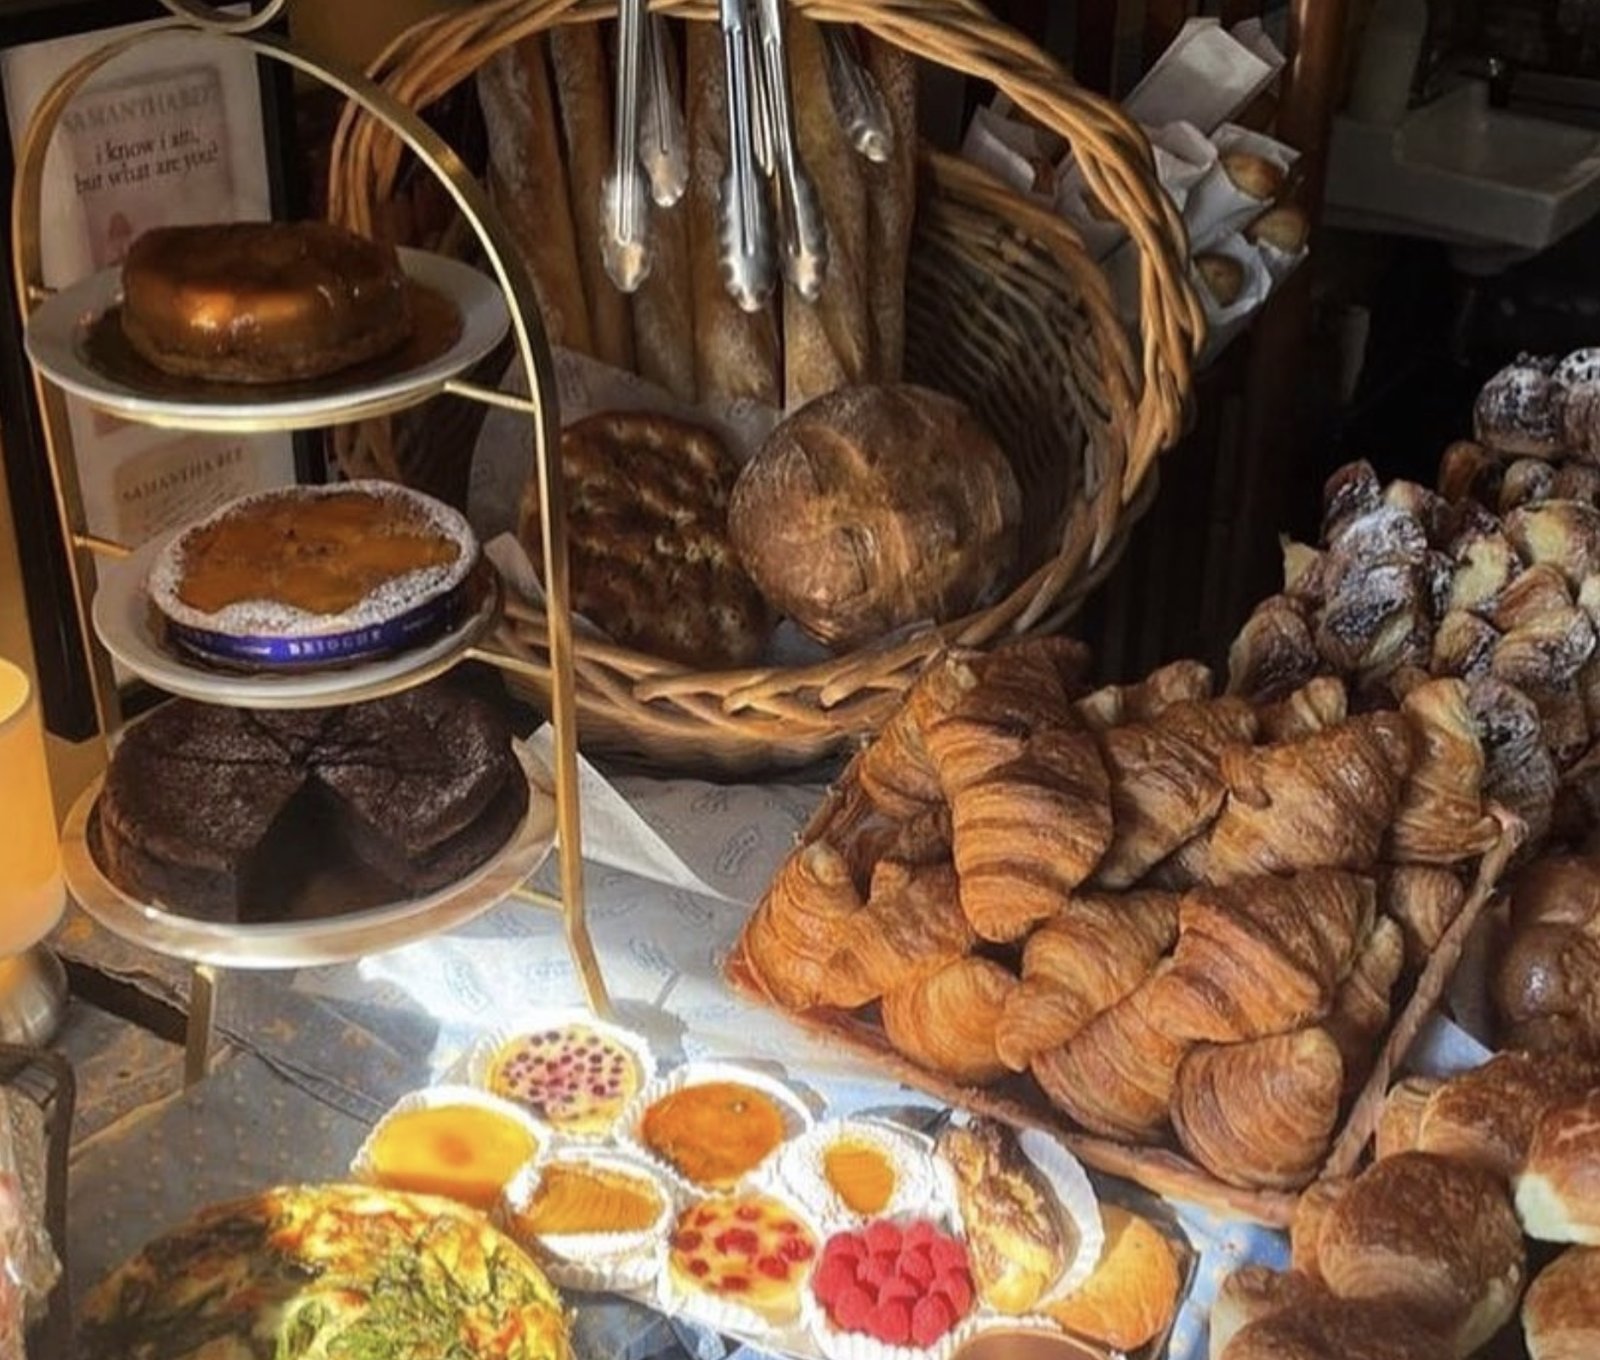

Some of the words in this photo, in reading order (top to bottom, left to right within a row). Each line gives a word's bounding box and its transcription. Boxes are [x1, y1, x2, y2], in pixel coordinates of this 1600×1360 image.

[105, 138, 155, 162] know
[74, 171, 103, 196] but
[107, 162, 150, 187] what
[155, 158, 182, 175] are
